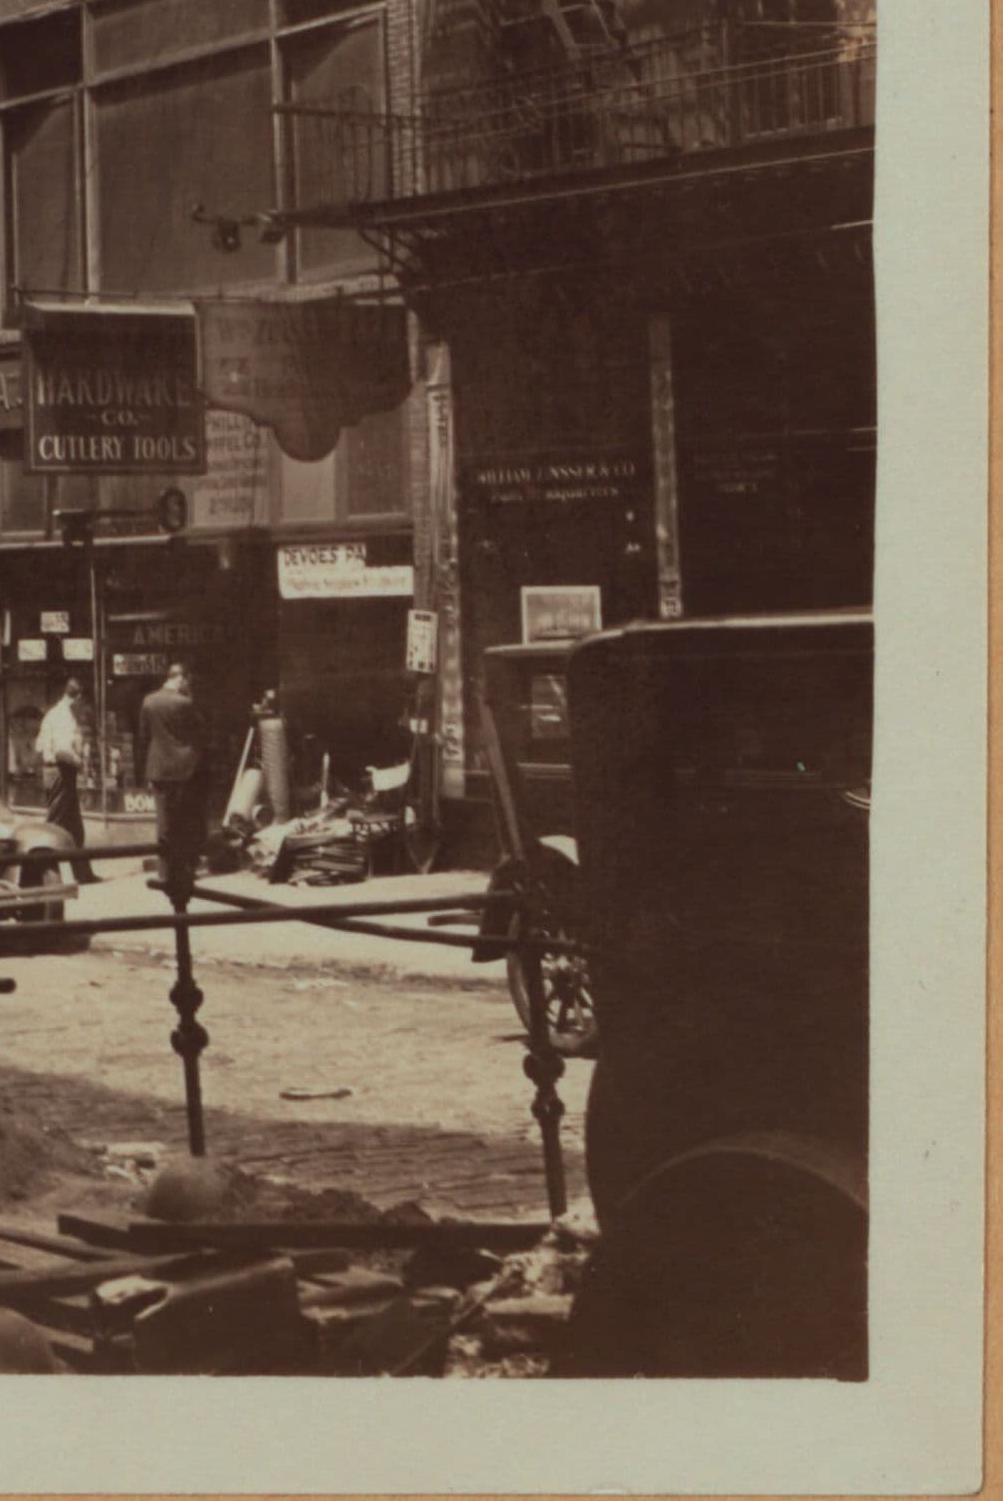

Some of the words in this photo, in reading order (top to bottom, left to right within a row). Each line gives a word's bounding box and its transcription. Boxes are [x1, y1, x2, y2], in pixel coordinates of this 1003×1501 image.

[36, 368, 191, 407] HARDWARE
[100, 409, 139, 427] CO.
[37, 434, 124, 461] CUTLERY
[134, 434, 197, 461] TOOLS
[478, 467, 531, 485] WILLIAM
